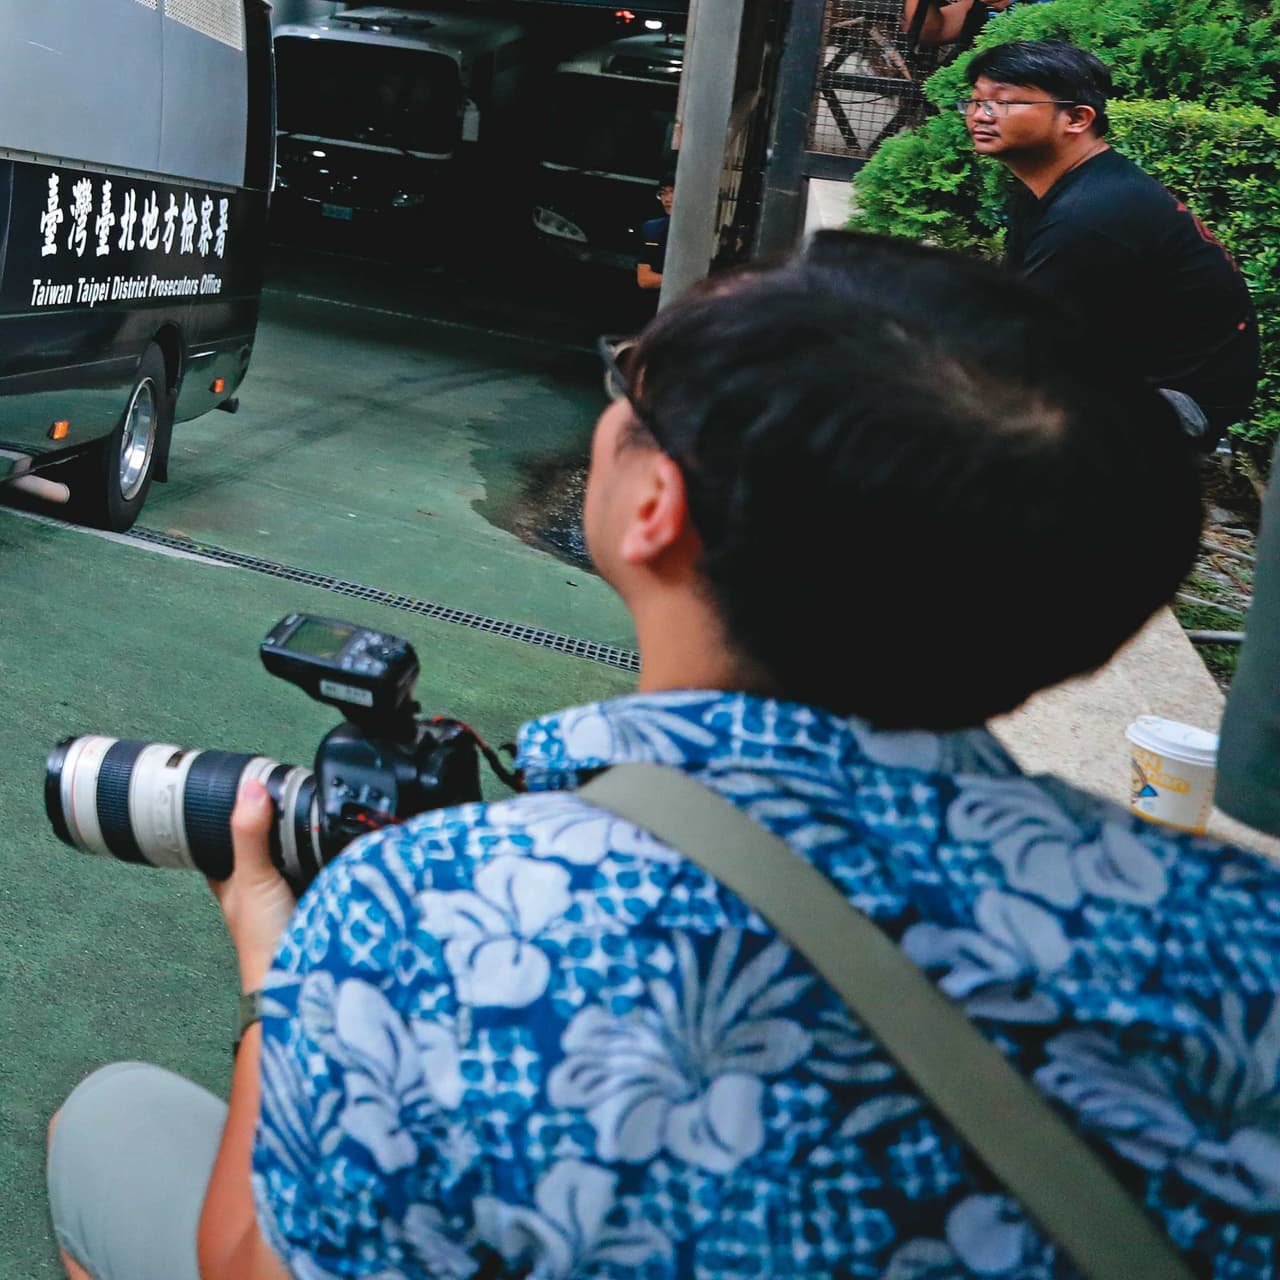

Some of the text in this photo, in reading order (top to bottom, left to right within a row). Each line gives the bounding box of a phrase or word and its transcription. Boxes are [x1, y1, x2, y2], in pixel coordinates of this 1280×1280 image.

[40, 172, 229, 259] 臺灣臺北地方檢察署
[31, 273, 222, 308] Taiwan Taipei District Prosecutors Office
